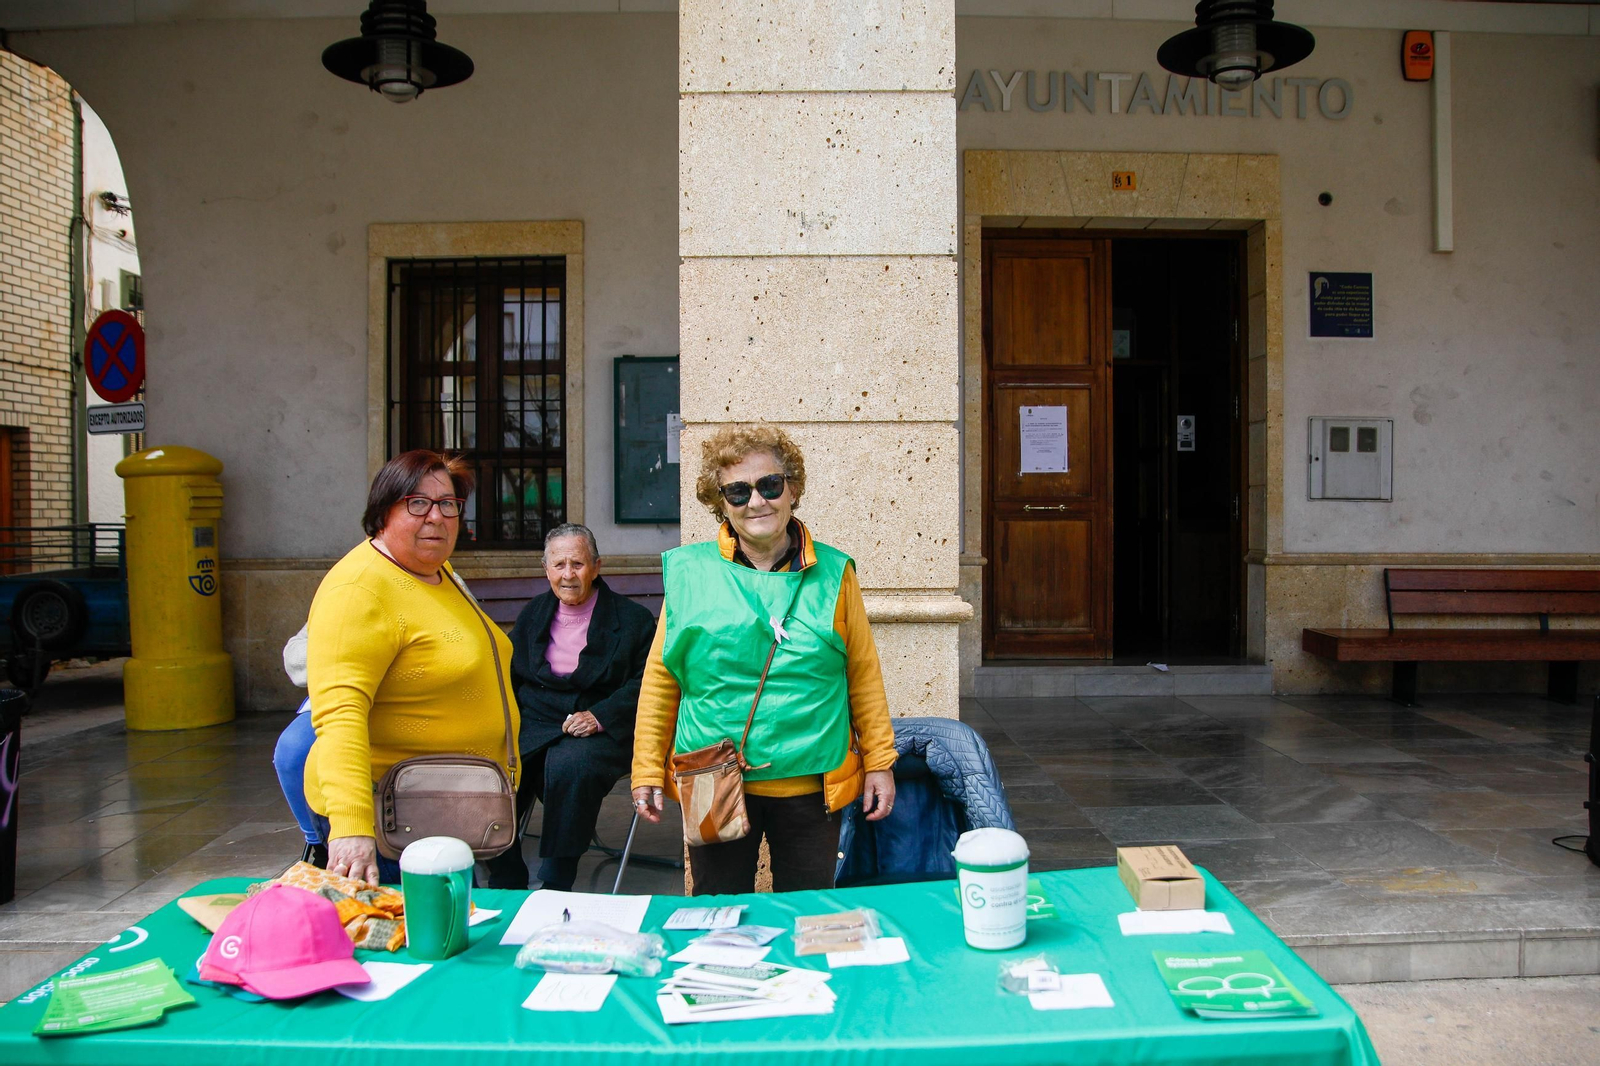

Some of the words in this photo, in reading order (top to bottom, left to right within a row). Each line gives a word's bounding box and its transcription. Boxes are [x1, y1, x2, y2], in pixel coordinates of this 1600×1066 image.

[958, 69, 1355, 120] AYUNTAMIENTO
[89, 412, 110, 426] EXCEPTO
[110, 410, 143, 425] AUTORIZADOS
